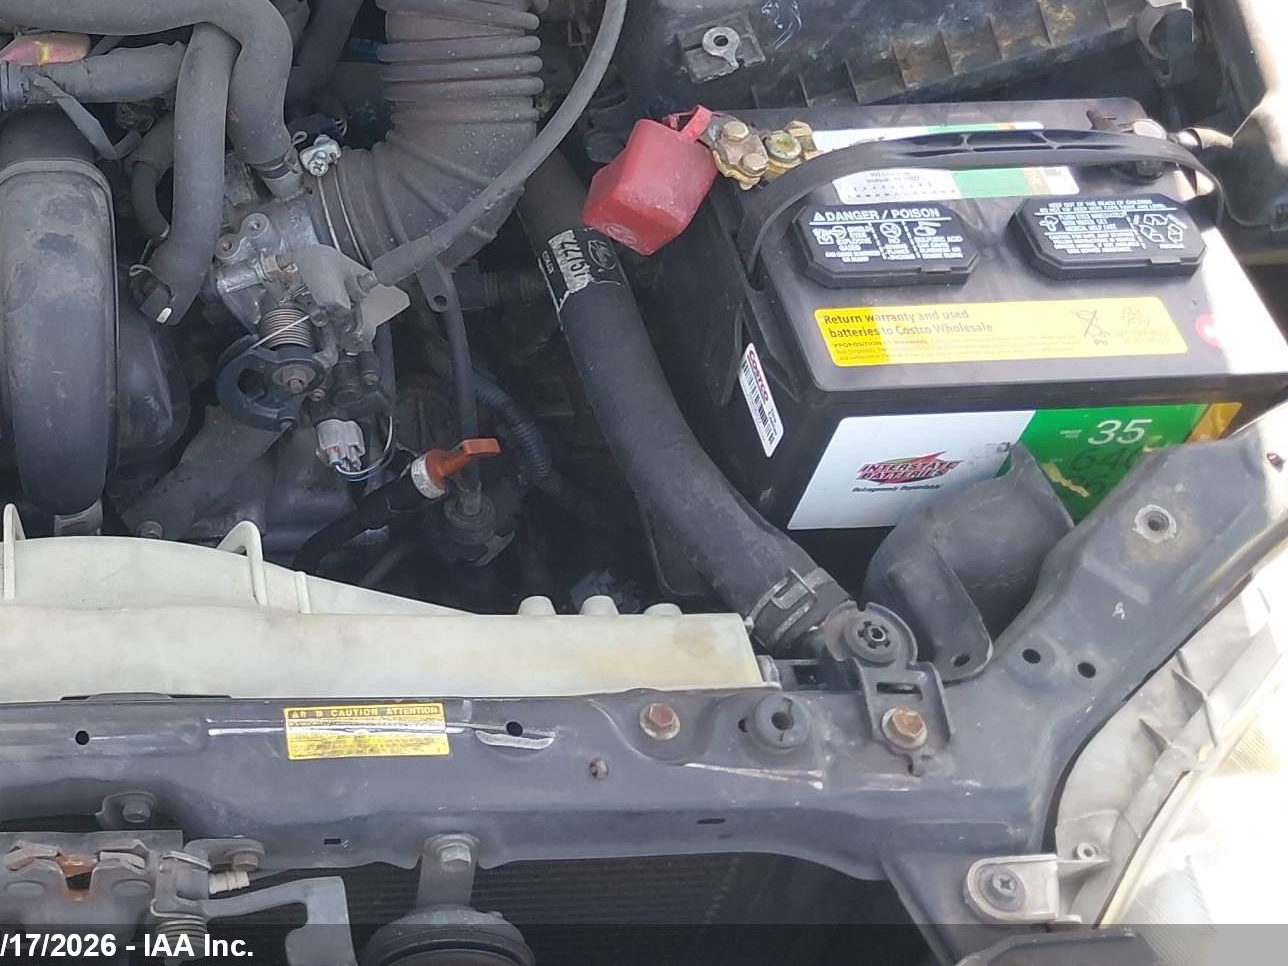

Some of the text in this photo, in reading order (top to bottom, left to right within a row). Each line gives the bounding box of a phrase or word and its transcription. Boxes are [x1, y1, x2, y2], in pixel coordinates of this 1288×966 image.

[825, 207, 941, 222] DANGER / POISON
[823, 309, 969, 325] Return warranty and used
[828, 321, 993, 338] batteries to Costco Wholesale
[748, 349, 769, 402] COSTCO
[1087, 418, 1153, 445] 35
[861, 461, 959, 472] INTERSTATE
[860, 469, 948, 480] BATTERIES
[330, 707, 379, 718] CAUTION
[386, 705, 438, 716] ATTENTION
